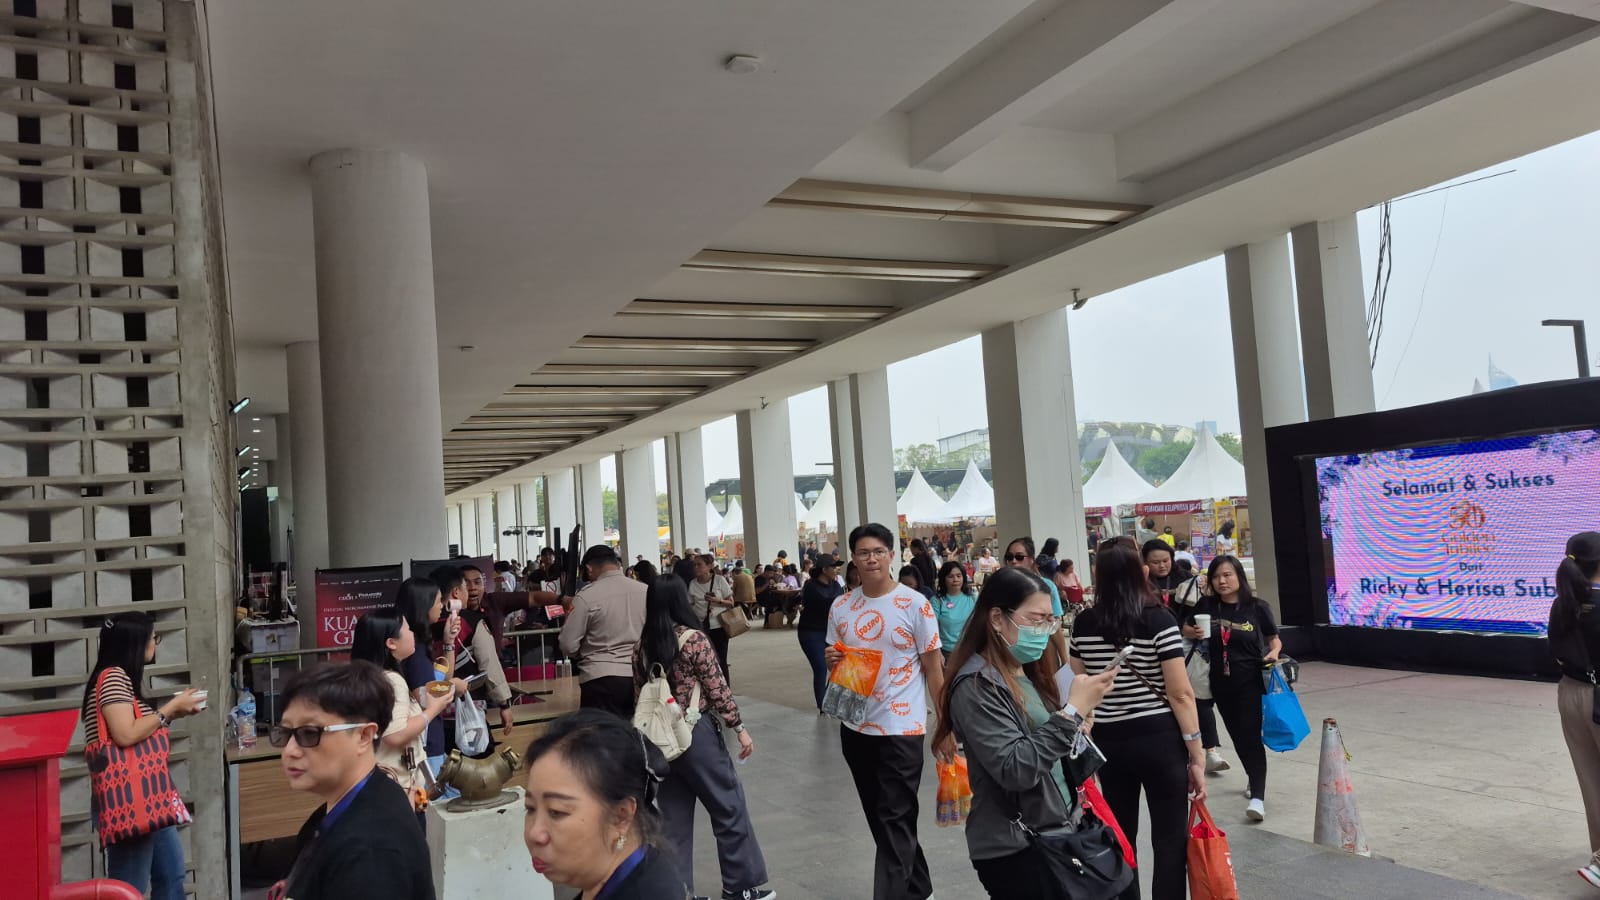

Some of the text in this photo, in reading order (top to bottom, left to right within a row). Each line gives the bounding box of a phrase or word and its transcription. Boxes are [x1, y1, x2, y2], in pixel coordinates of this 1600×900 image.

[1383, 470, 1554, 497] Selamat & Sukses
[1360, 576, 1558, 599] Ricky & Herisa Sub
[324, 615, 358, 632] KUA
[858, 615, 880, 636] SOSRO
